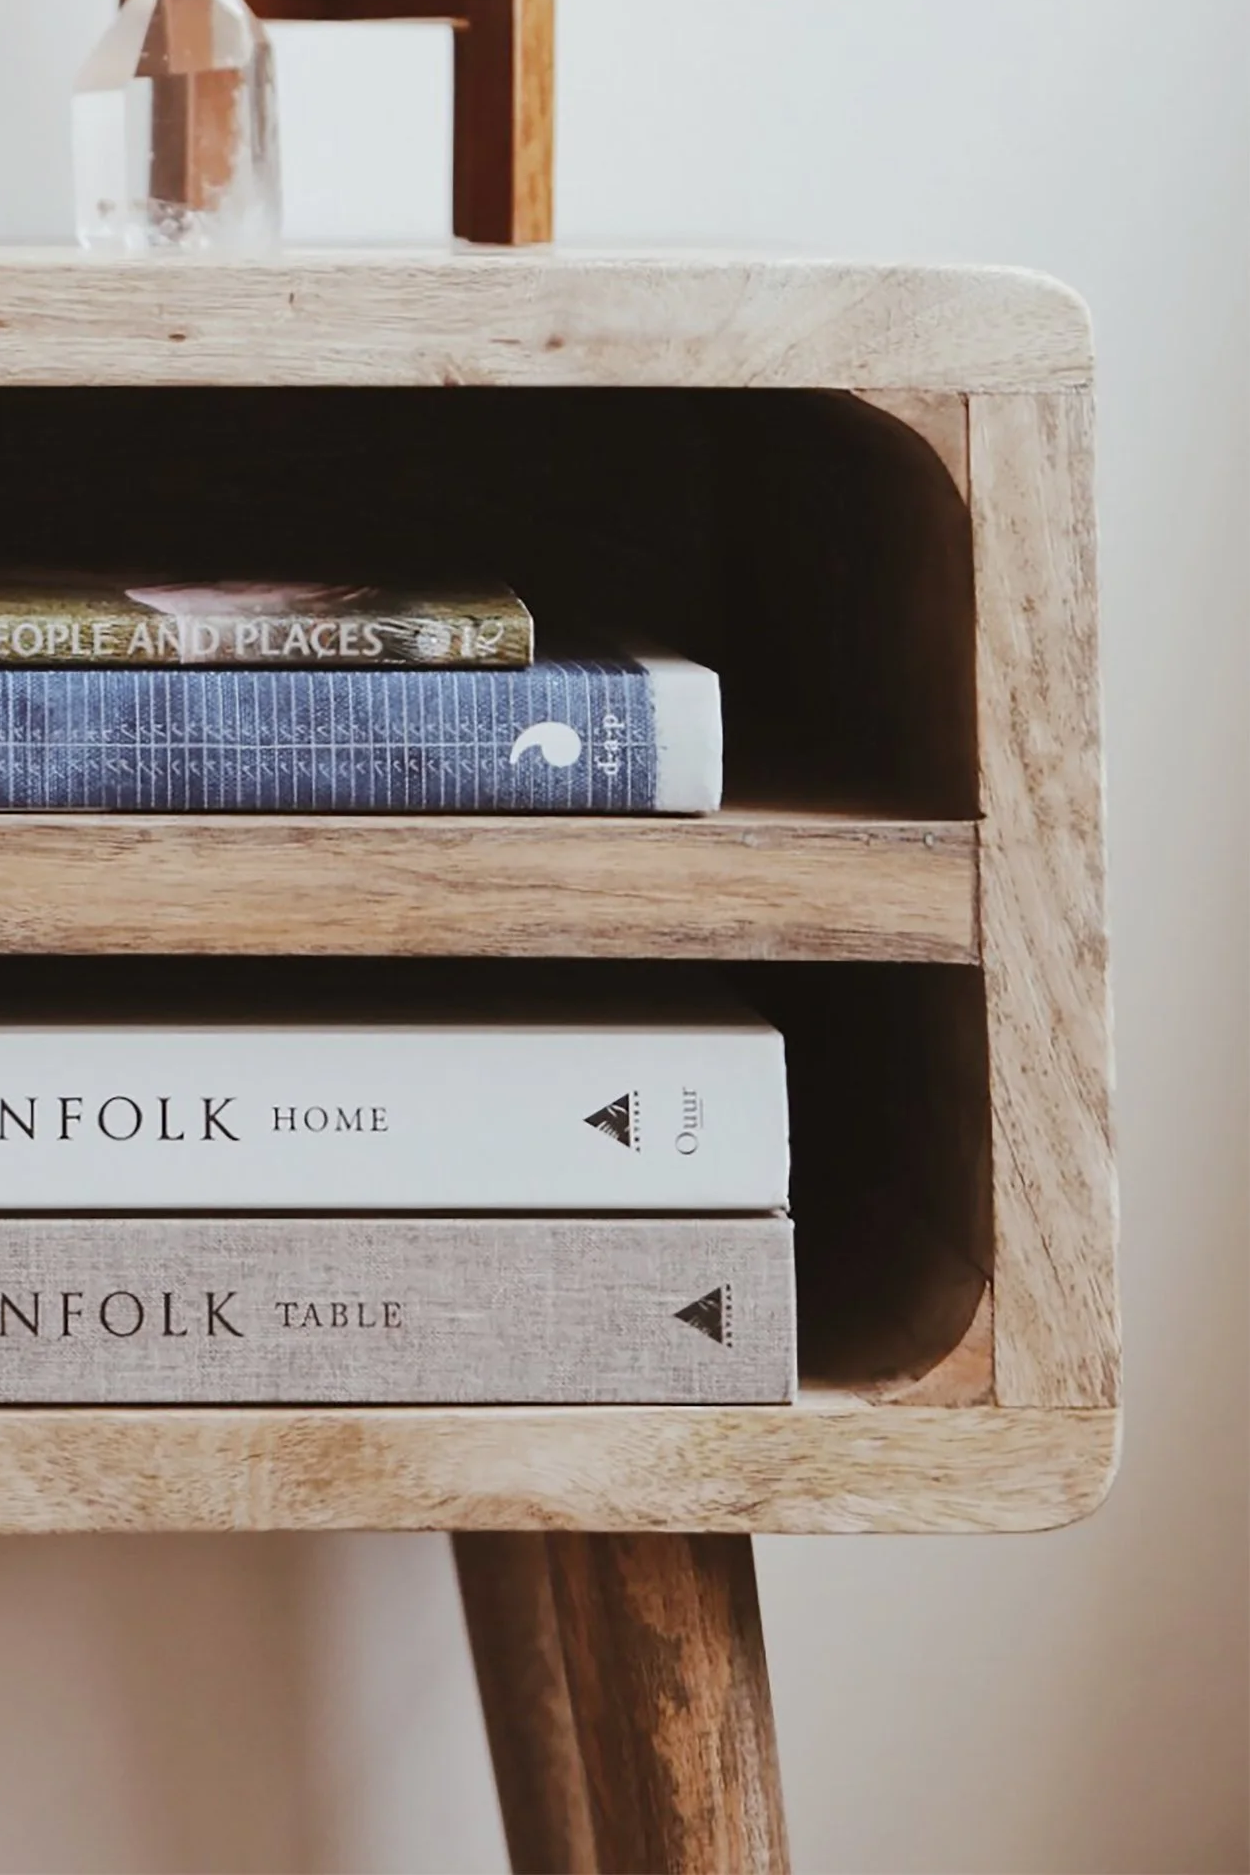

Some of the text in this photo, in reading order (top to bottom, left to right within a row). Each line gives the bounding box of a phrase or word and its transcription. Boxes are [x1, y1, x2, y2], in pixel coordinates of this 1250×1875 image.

[126, 623, 220, 657] AND
[235, 623, 383, 658] PLACES
[272, 1106, 389, 1132] HOME
[675, 1087, 698, 1154] Ouur
[275, 1302, 403, 1328] TABLE
